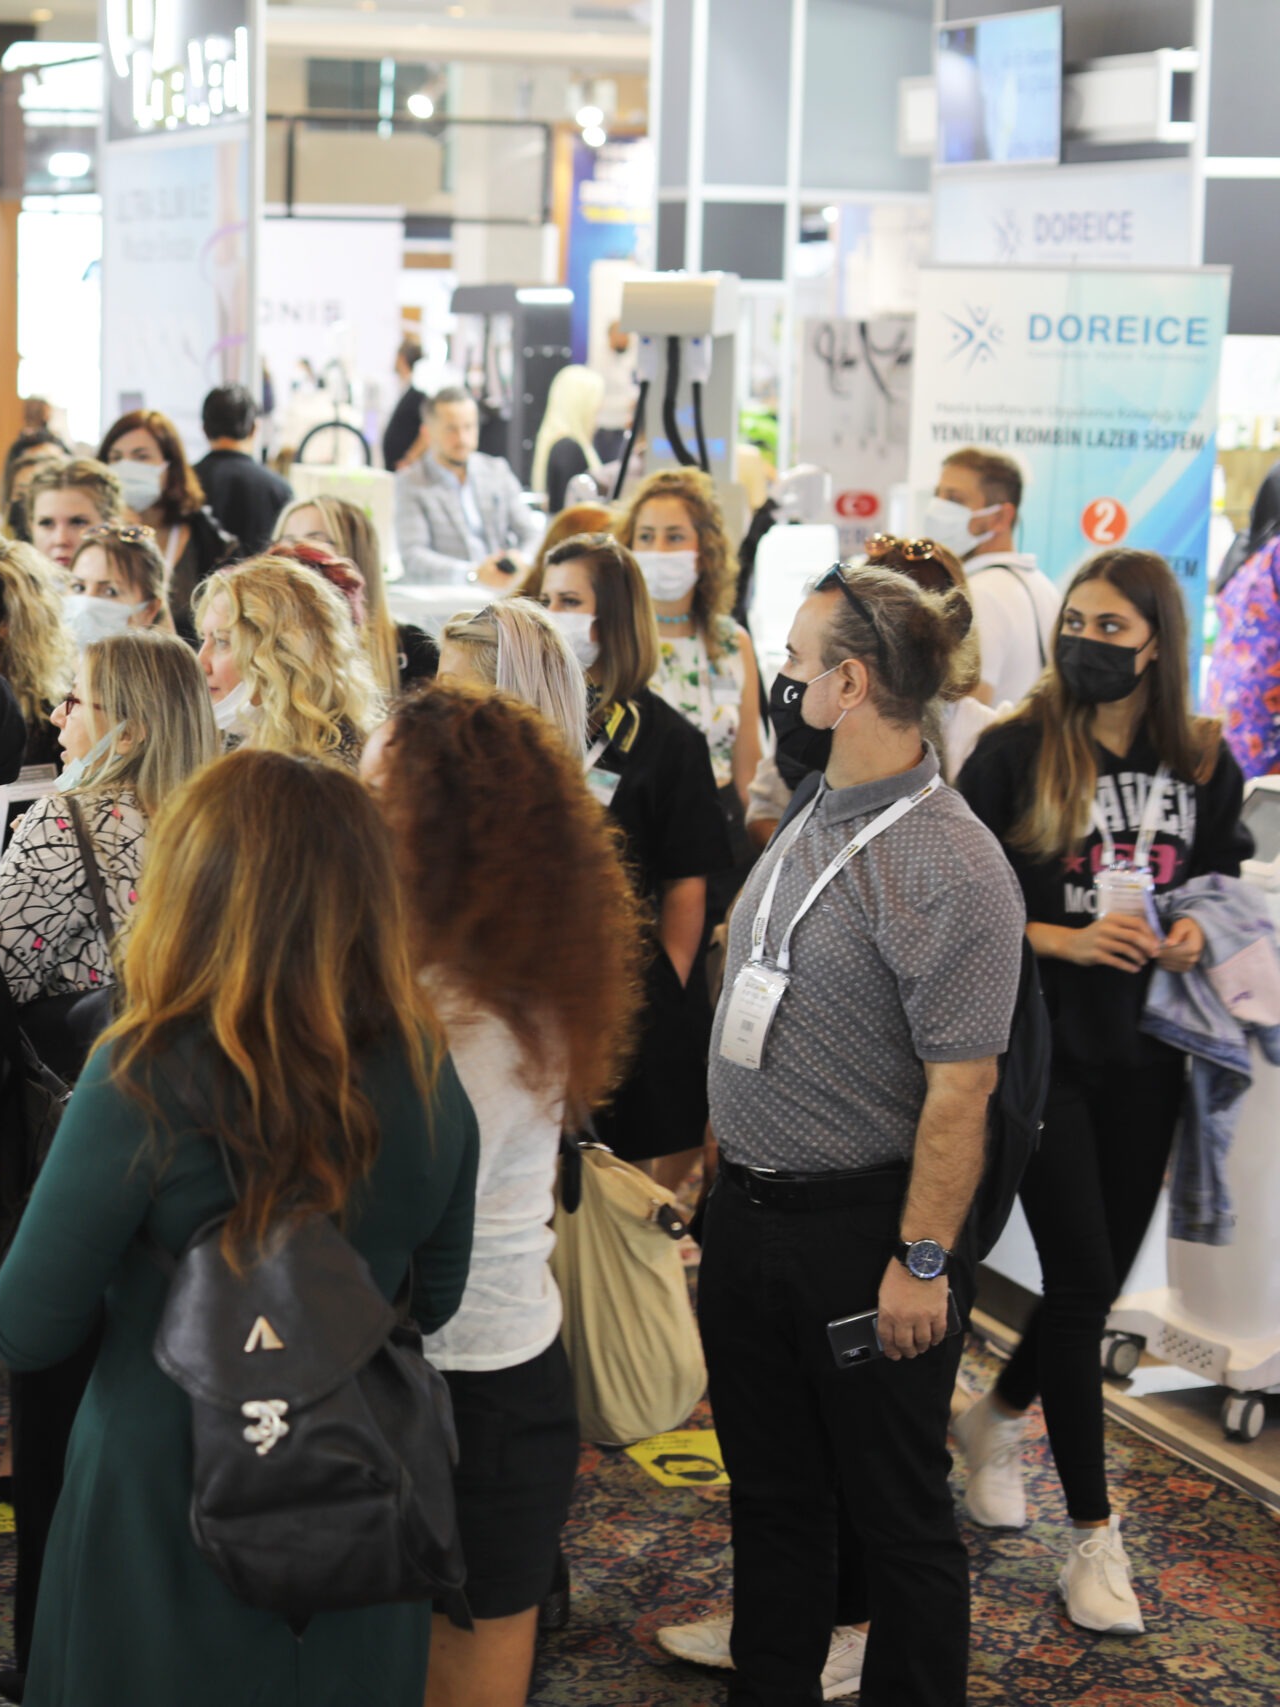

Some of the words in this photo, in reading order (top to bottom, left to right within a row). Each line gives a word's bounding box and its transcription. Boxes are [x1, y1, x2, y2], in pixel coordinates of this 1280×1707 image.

[1034, 211, 1134, 245] DOREICE
[1028, 313, 1210, 347] DOREICE
[1087, 428, 1139, 448] LAZER
[1143, 427, 1205, 452] SİSTEM
[1093, 500, 1116, 543] 2
